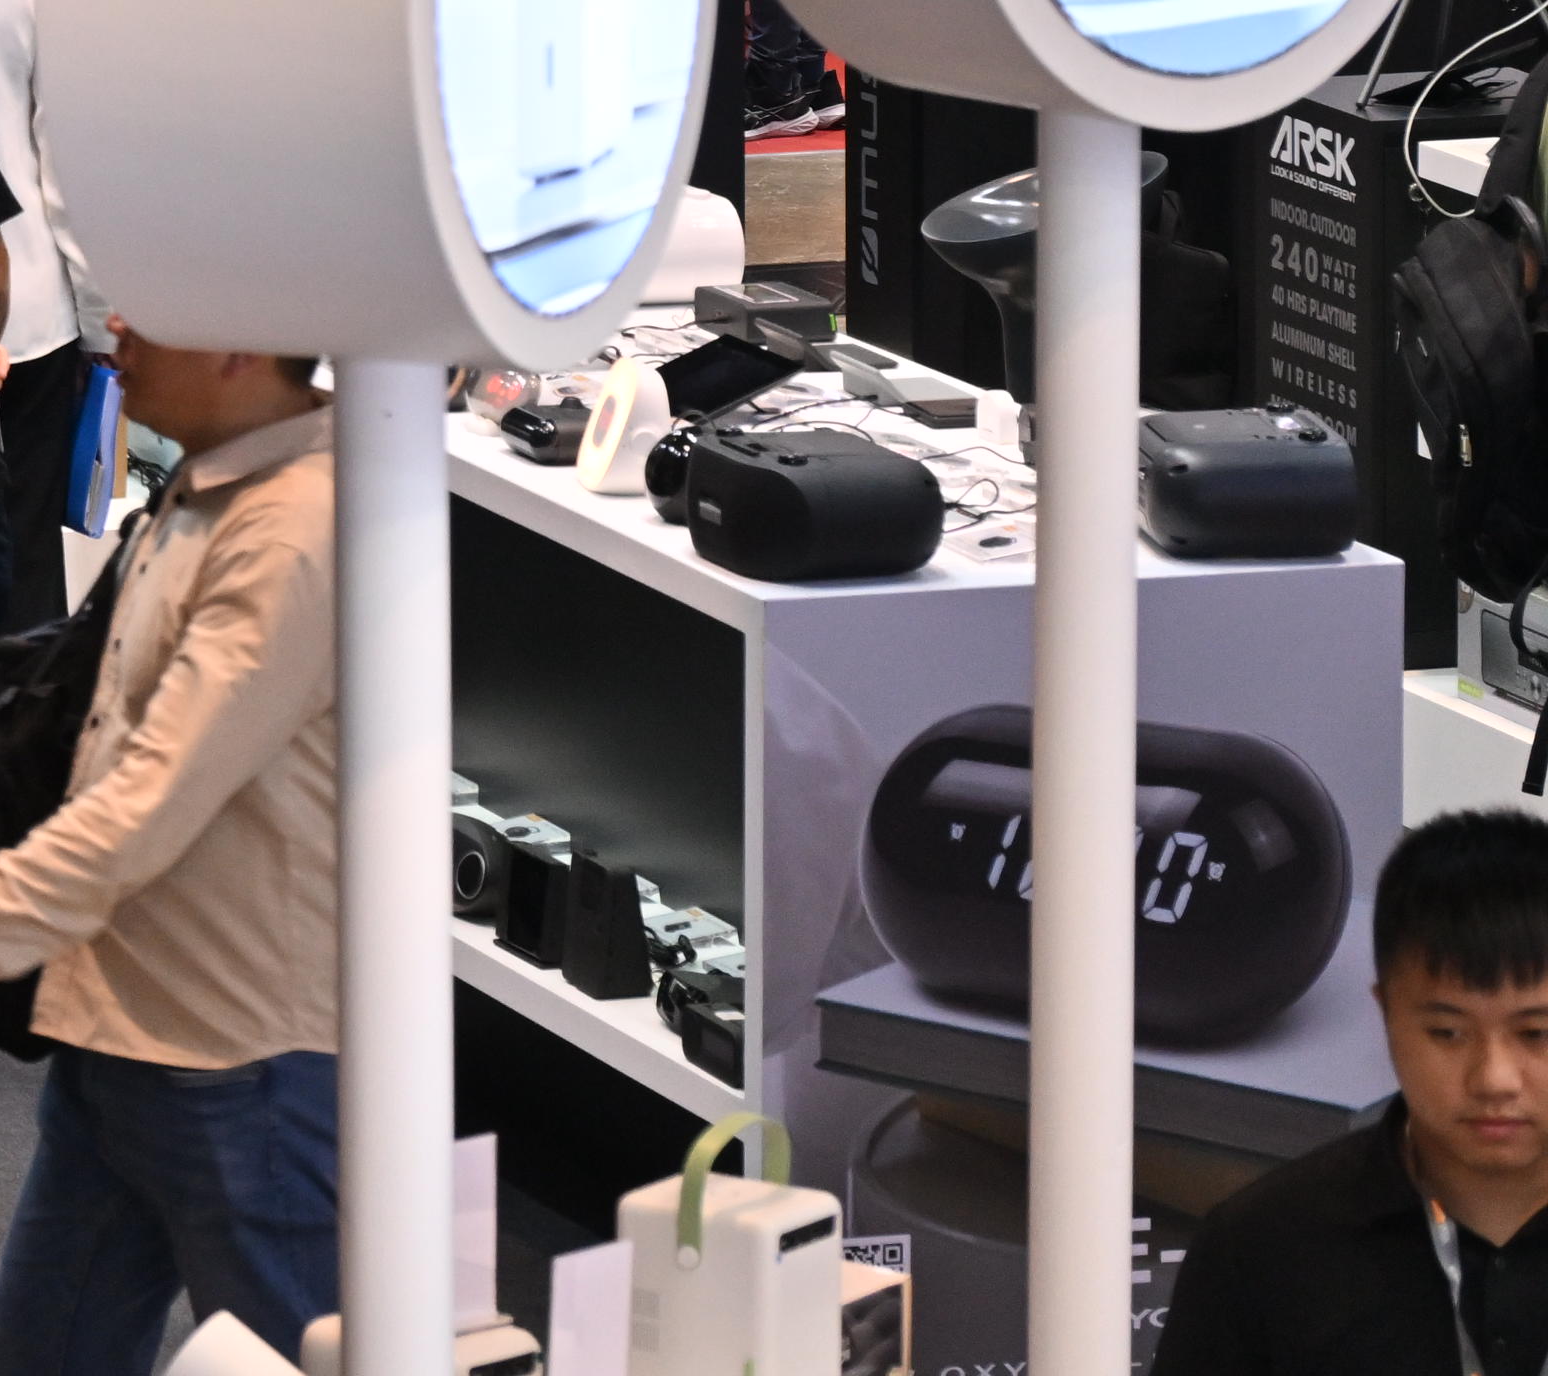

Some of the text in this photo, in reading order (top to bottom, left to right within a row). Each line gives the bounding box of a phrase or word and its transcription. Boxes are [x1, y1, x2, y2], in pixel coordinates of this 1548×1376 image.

[1269, 114, 1357, 187] ARSK
[1270, 233, 1357, 284] 240 WATT
[1271, 284, 1357, 335] 40 HRS PLAYTIME
[1321, 272, 1356, 300] RMS
[1271, 320, 1357, 372] ALUMINUM SHELL
[1271, 356, 1357, 410] WIRELESS
